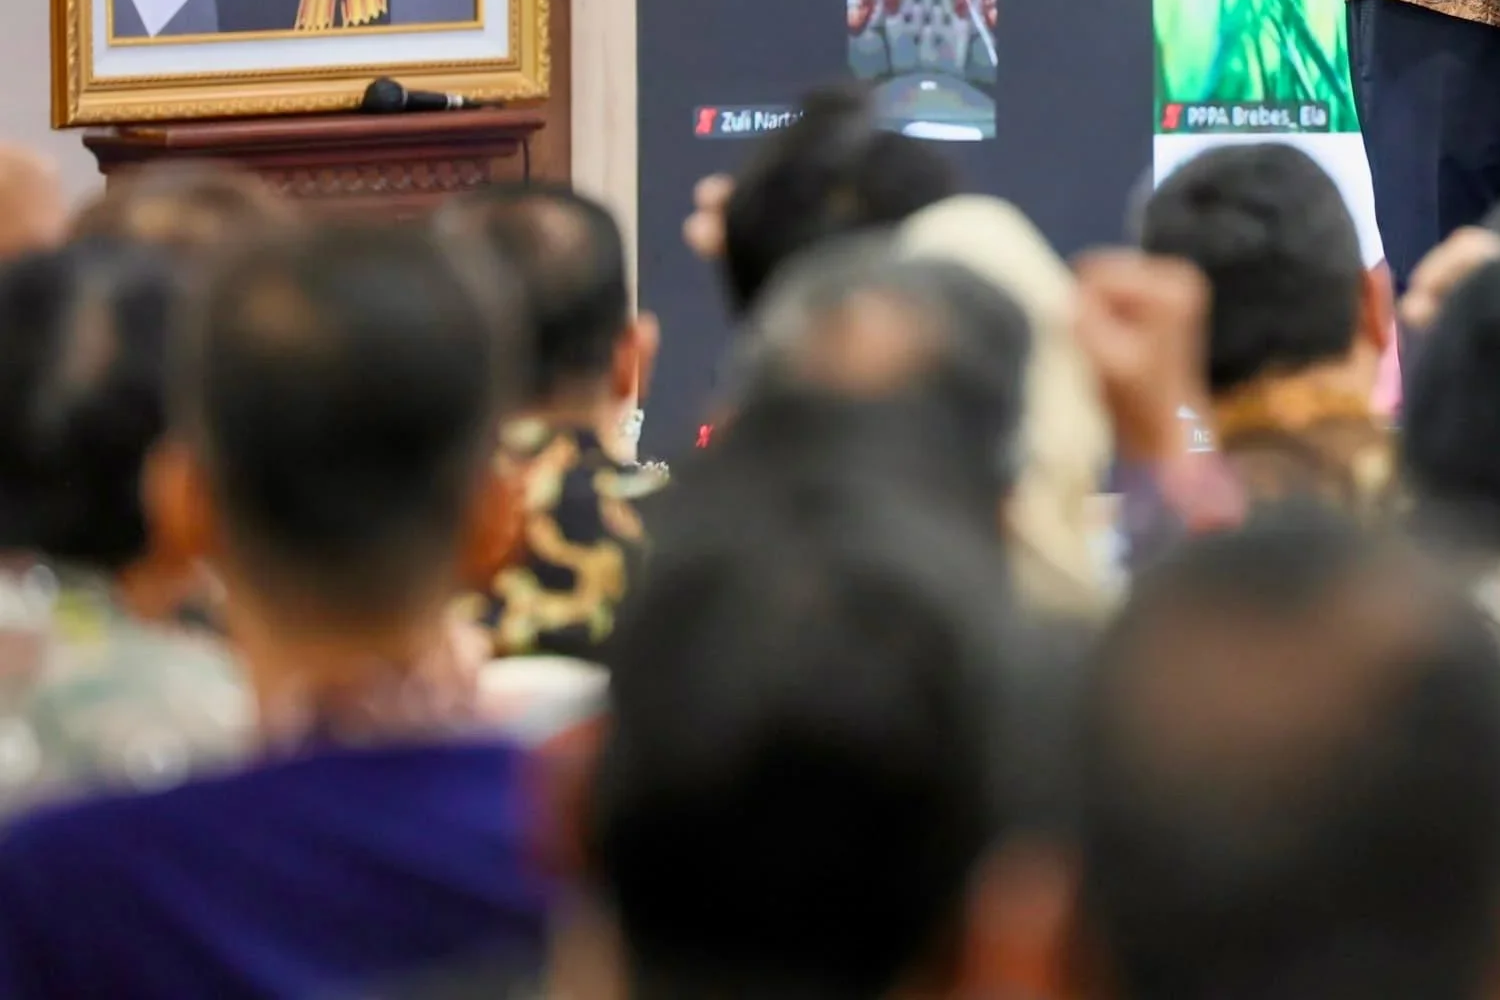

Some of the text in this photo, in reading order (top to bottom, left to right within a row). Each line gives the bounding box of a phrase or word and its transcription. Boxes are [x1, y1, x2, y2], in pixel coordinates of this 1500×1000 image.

[721, 109, 752, 132] Zuli
[1188, 105, 1229, 127] PPPA
[1300, 104, 1327, 126] Ela
